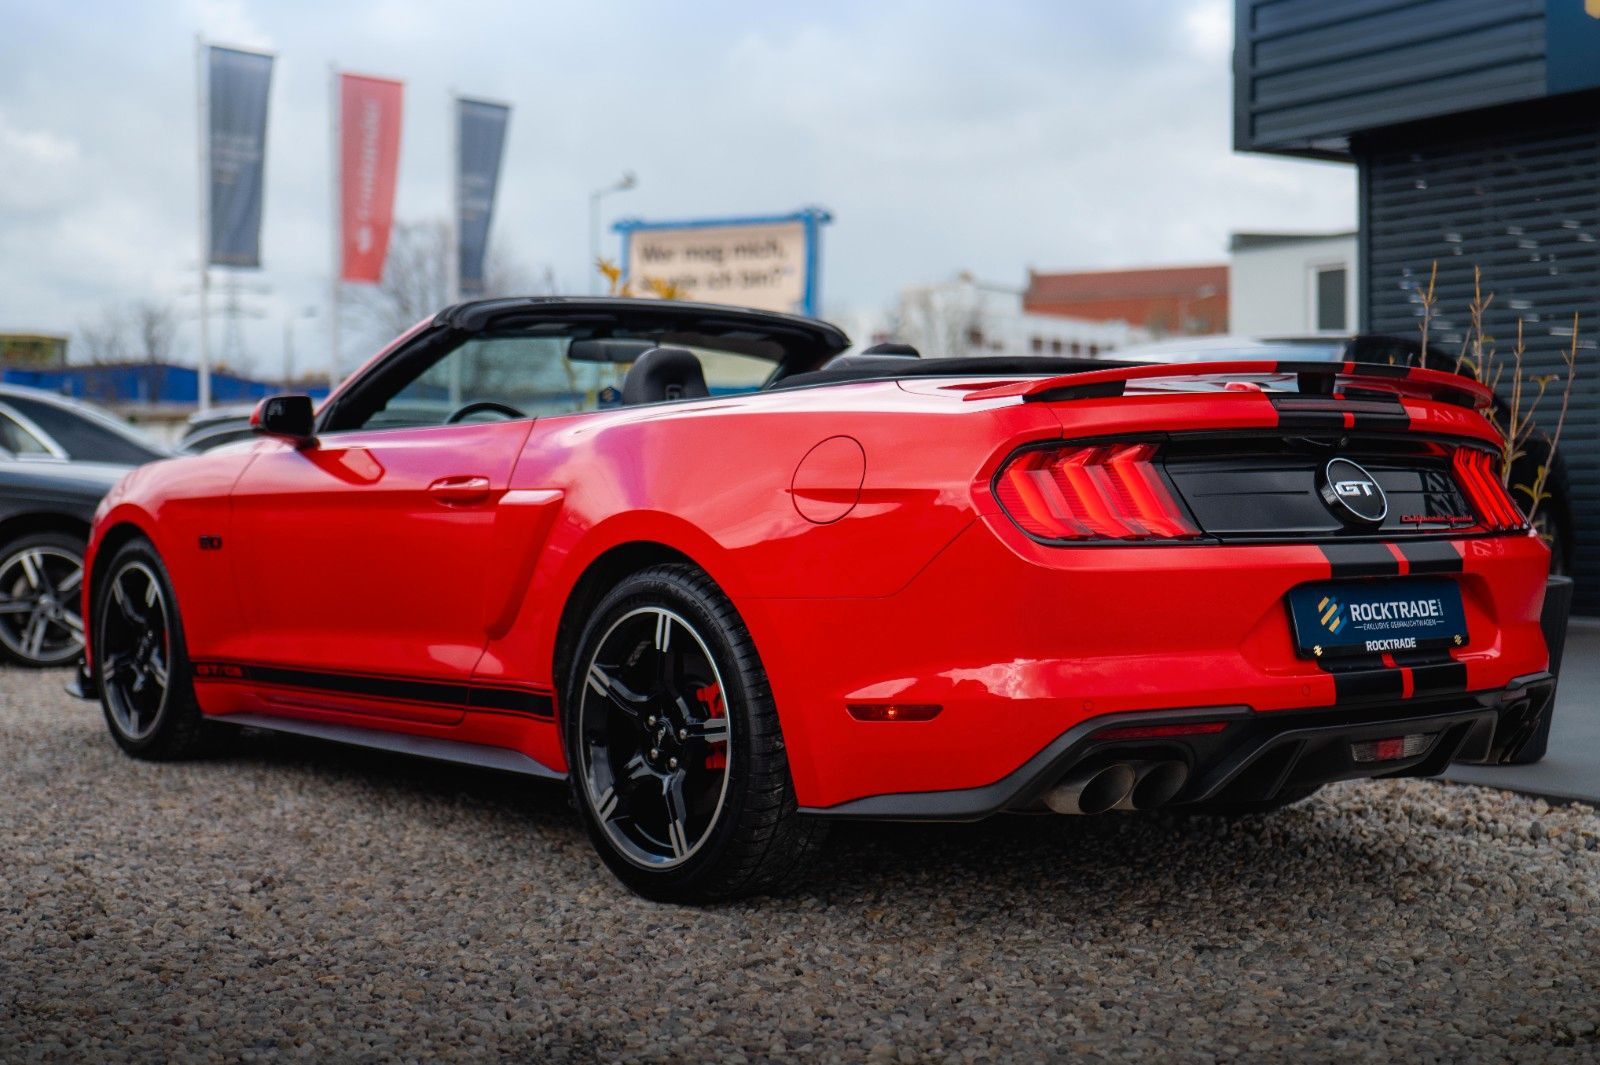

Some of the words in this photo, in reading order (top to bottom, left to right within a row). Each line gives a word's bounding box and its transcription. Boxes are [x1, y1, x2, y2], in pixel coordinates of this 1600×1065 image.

[1334, 480, 1374, 497] GT
[1350, 599, 1438, 622] ROCKTRADE
[1363, 621, 1390, 631] EXKLUSIVE
[1390, 618, 1437, 629] GEBRAUCHTWAGEN
[1365, 637, 1417, 652] ROCKTRADE
